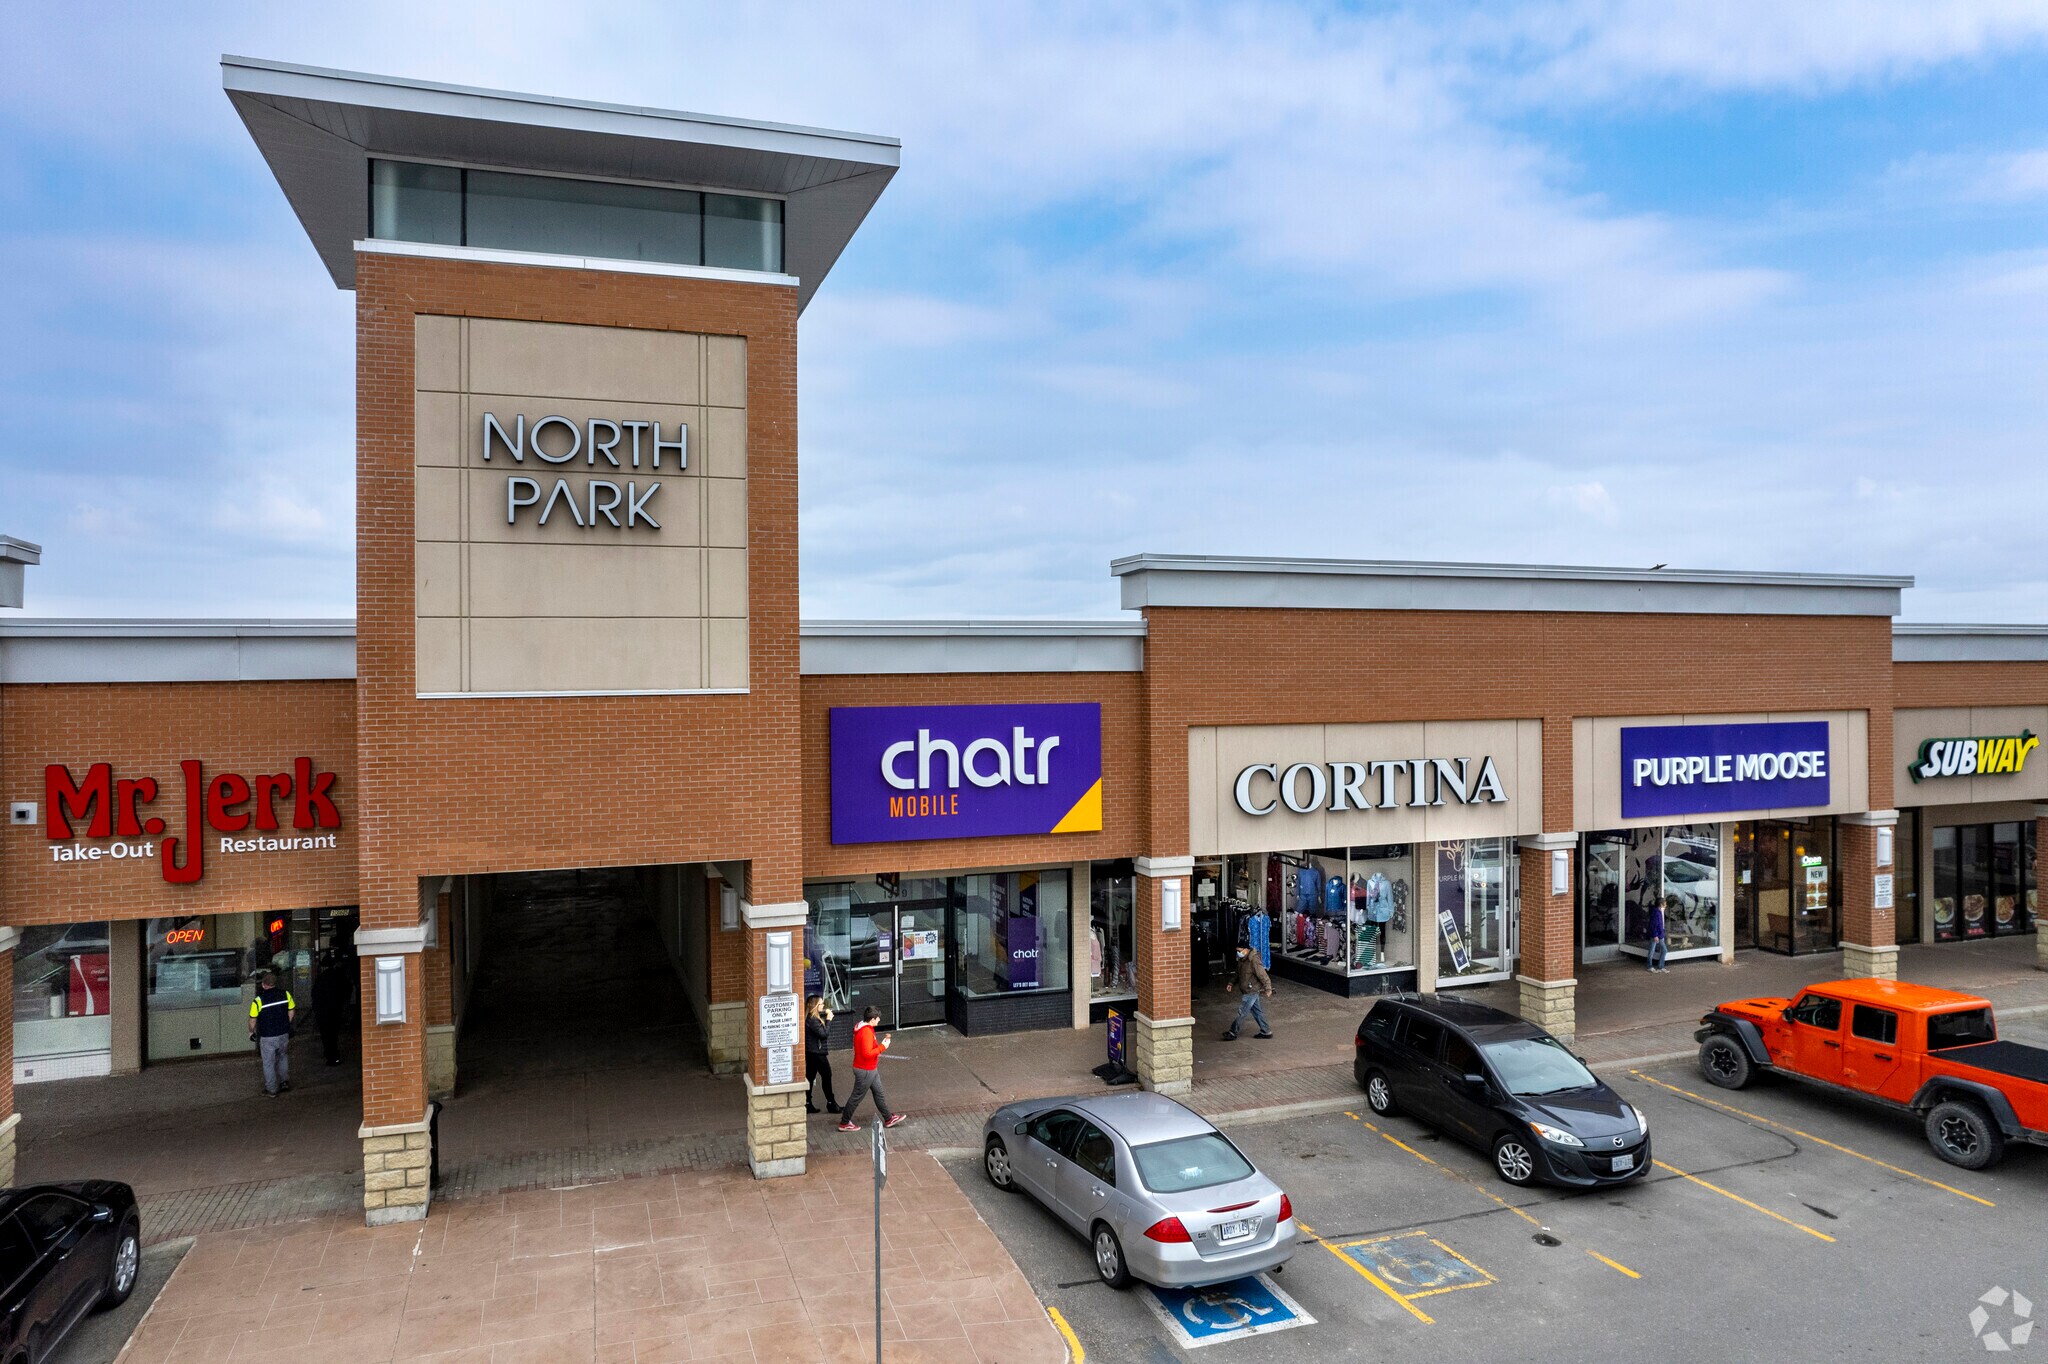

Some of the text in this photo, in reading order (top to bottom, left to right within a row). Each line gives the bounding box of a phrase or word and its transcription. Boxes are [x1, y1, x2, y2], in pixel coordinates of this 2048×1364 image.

[483, 412, 688, 469] NORTH
[507, 475, 662, 529] PARK
[881, 726, 1060, 790] chatr
[1633, 751, 1826, 787] PURPLE MOOSE
[1920, 736, 2040, 778] SUBWAY
[1233, 755, 1510, 816] CORTINA
[889, 794, 959, 818] MOBILE
[45, 757, 343, 884] Mr. Jerk
[49, 833, 337, 862] Take-Out Restaurant
[1802, 855, 1822, 865] Open
[1439, 874, 1458, 882] URPLE
[1810, 870, 1824, 879] NEW
[166, 929, 205, 945] OPEN
[270, 918, 284, 933] OPEN
[1013, 949, 1039, 959] chatr
[1722, 1007, 1763, 1020] RUBICON
